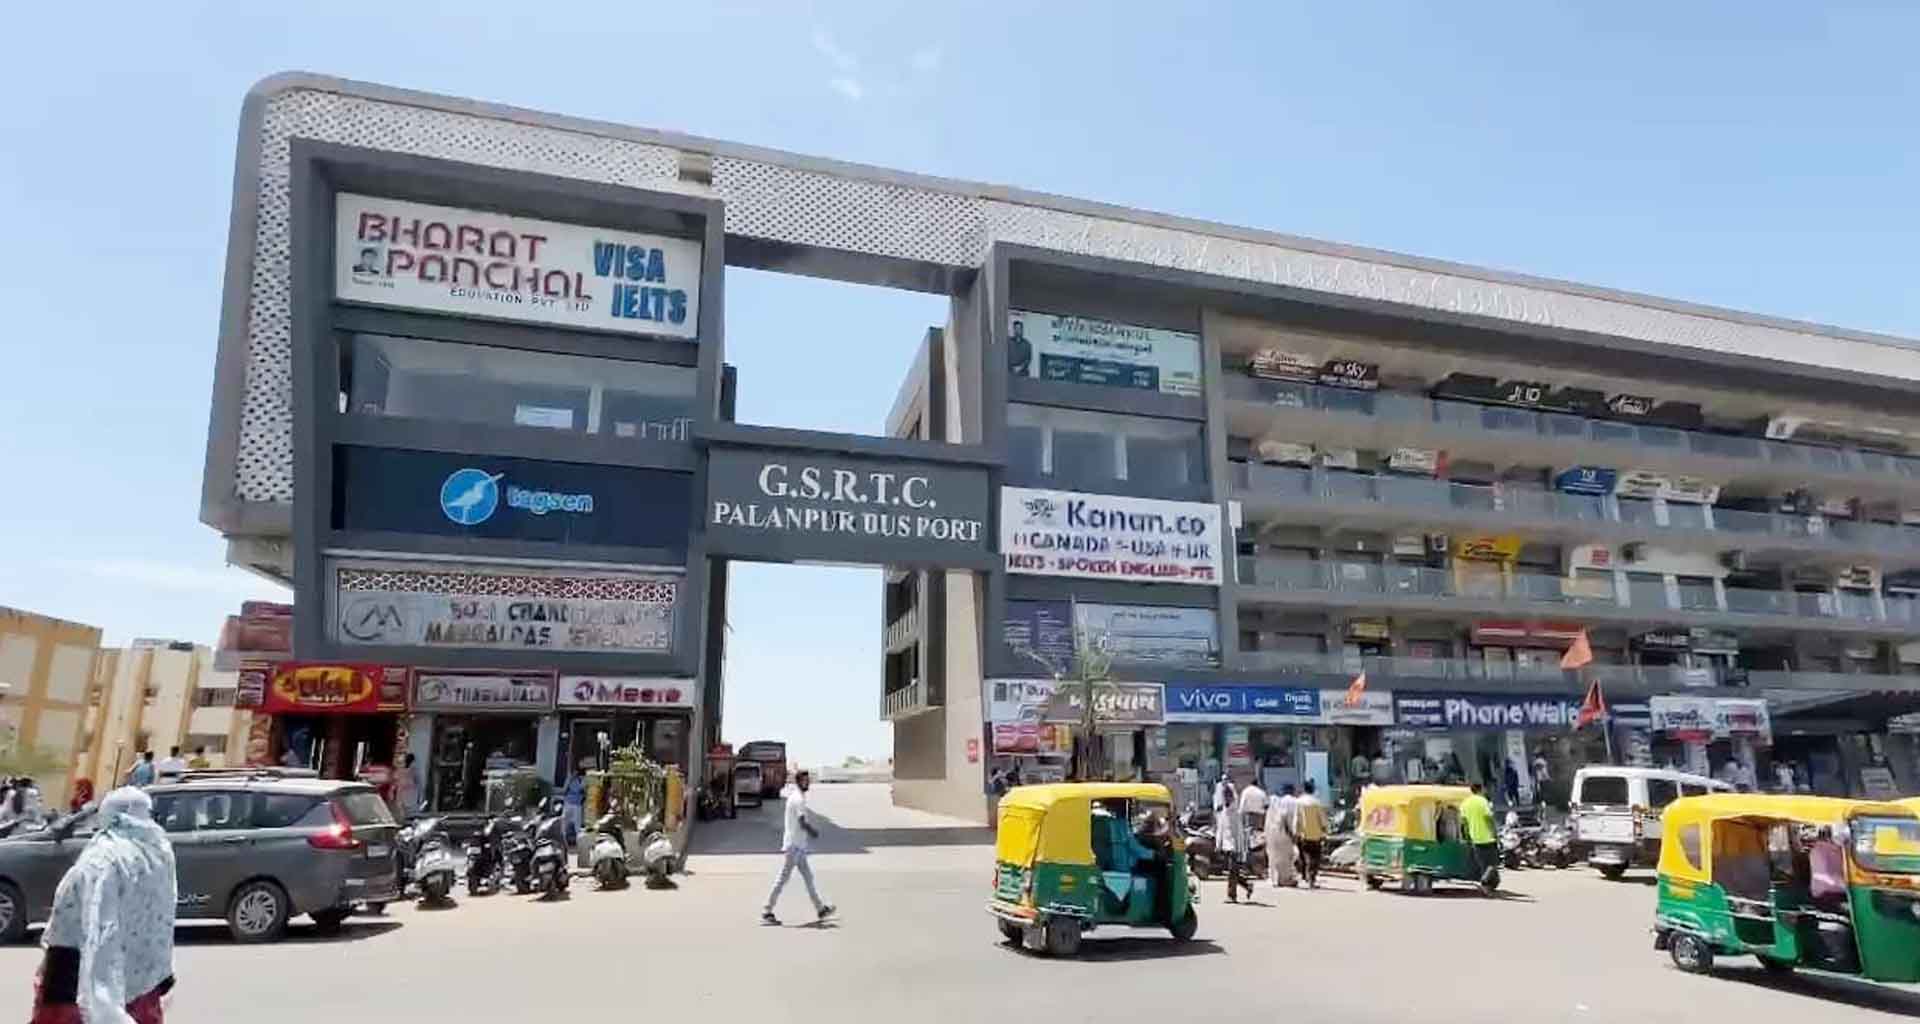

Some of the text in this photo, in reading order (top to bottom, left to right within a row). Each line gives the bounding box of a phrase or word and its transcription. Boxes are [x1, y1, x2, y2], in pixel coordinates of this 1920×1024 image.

[358, 211, 547, 263] BHARAT
[385, 248, 592, 301] PANCHAL
[594, 240, 666, 284] VISA
[612, 283, 688, 326] IELTS
[759, 464, 937, 509] G.S.R.T.C.
[712, 501, 856, 534] PALANPUR
[916, 516, 982, 542] PORT
[1030, 532, 1110, 553] CANADA
[1180, 688, 1232, 708] vivo
